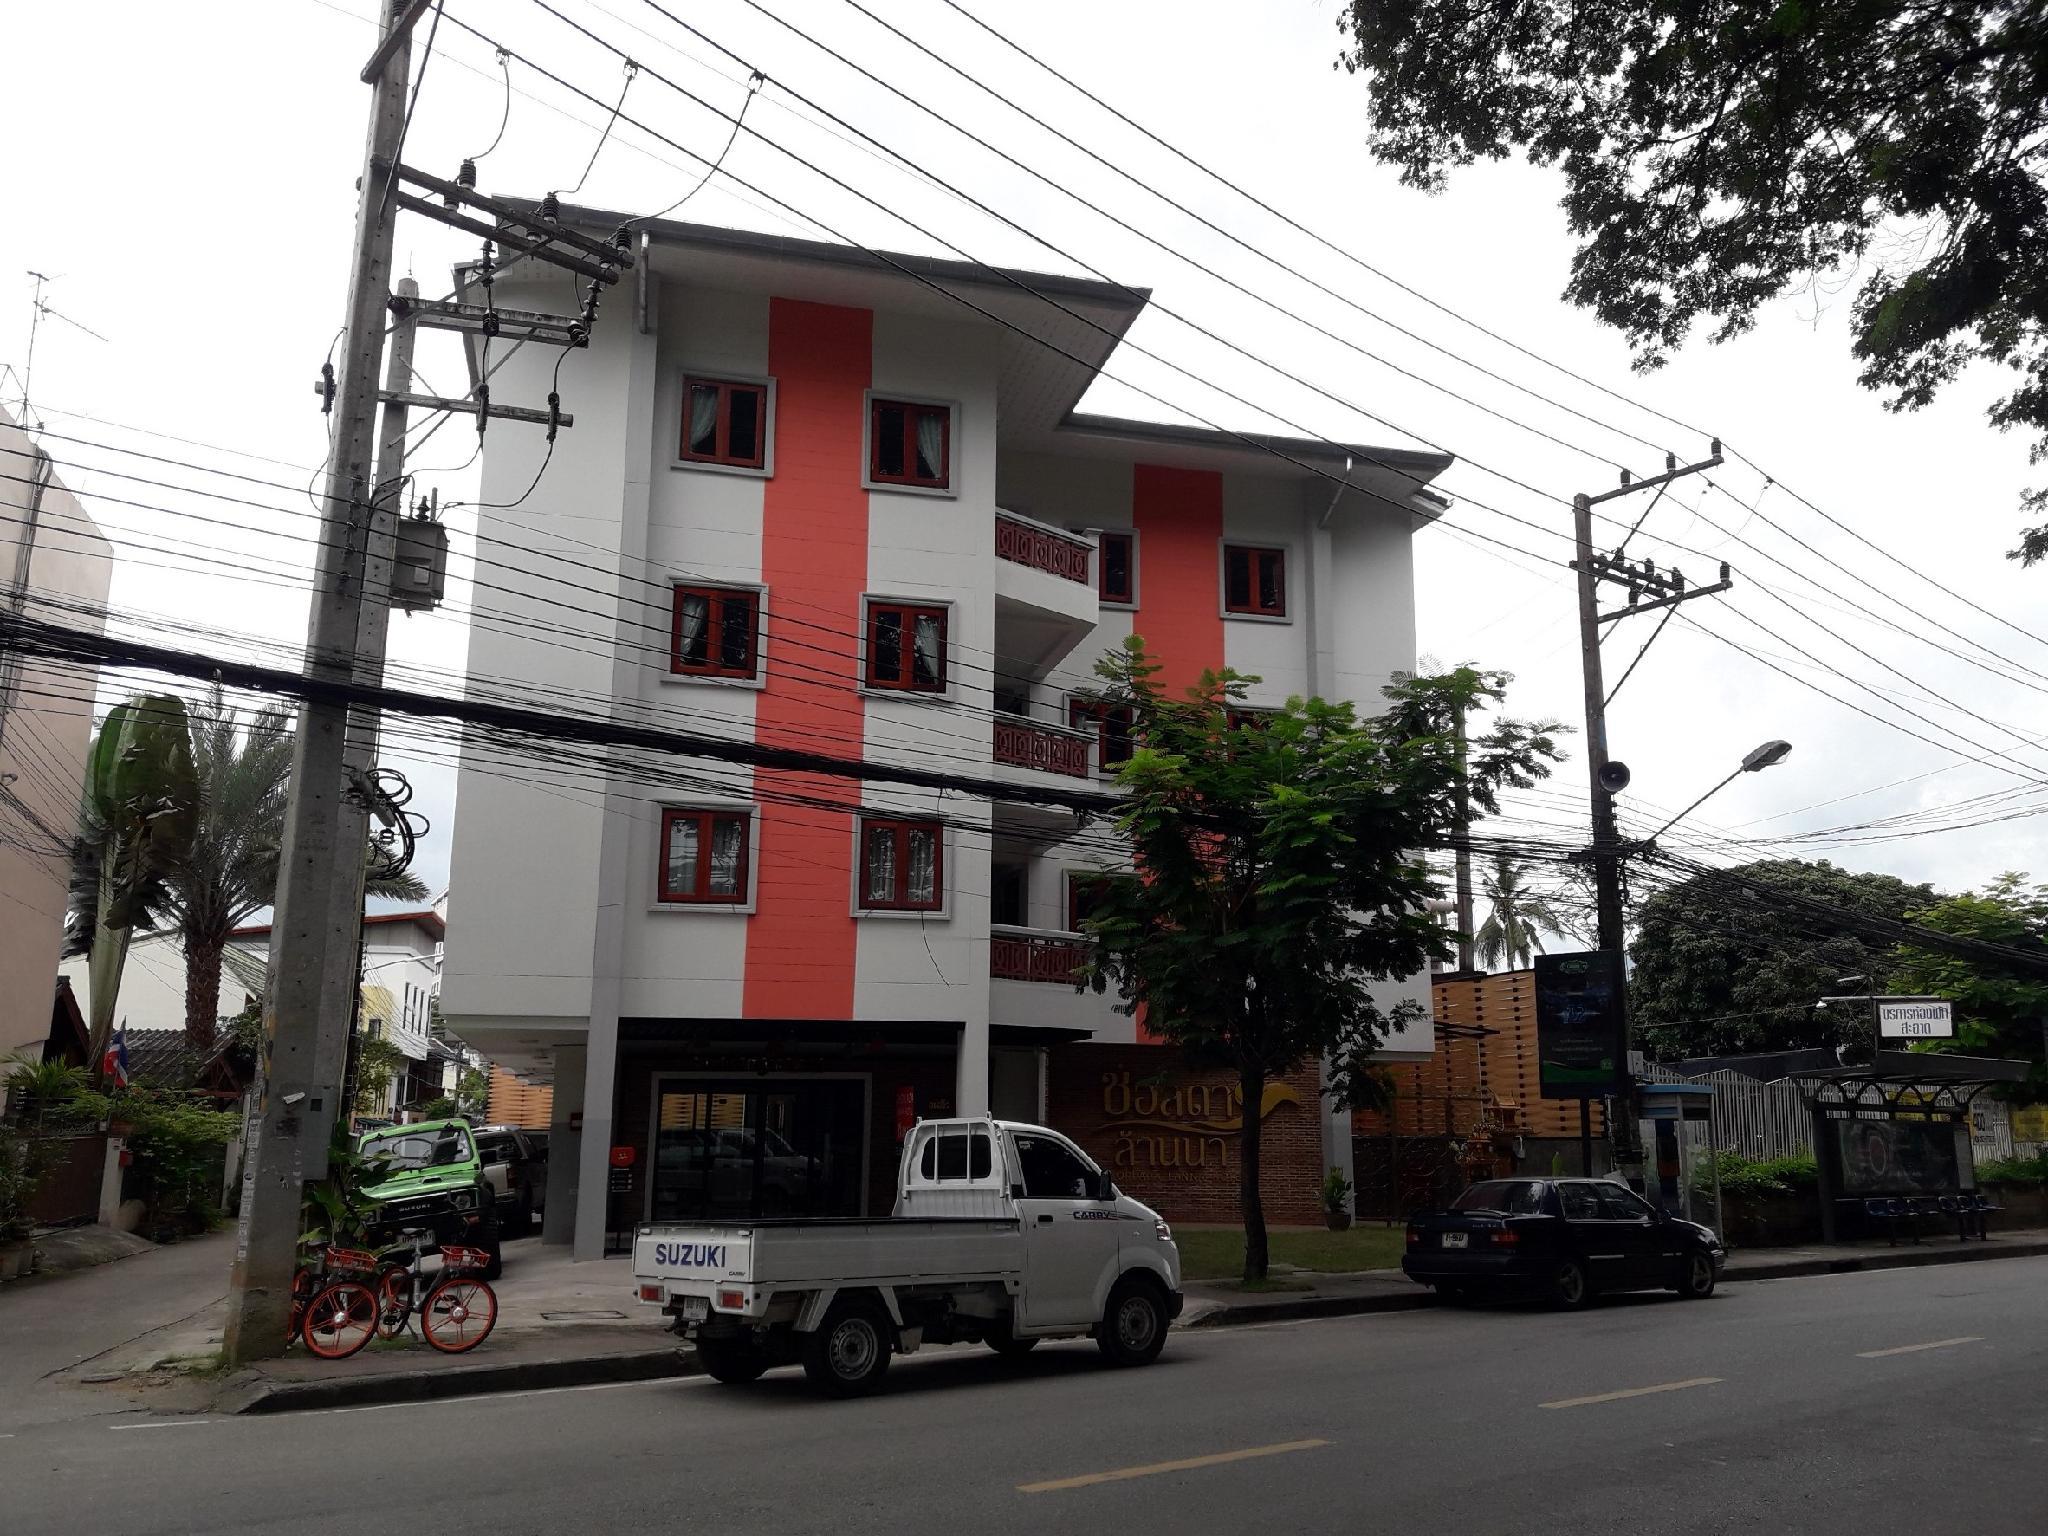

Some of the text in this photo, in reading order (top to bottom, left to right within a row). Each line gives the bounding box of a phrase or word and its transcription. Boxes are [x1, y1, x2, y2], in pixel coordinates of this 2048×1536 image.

[1114, 1129, 1228, 1168] ล้านนา
[1073, 1211, 1110, 1220] CARRY
[655, 1243, 726, 1268] SUZUKI
